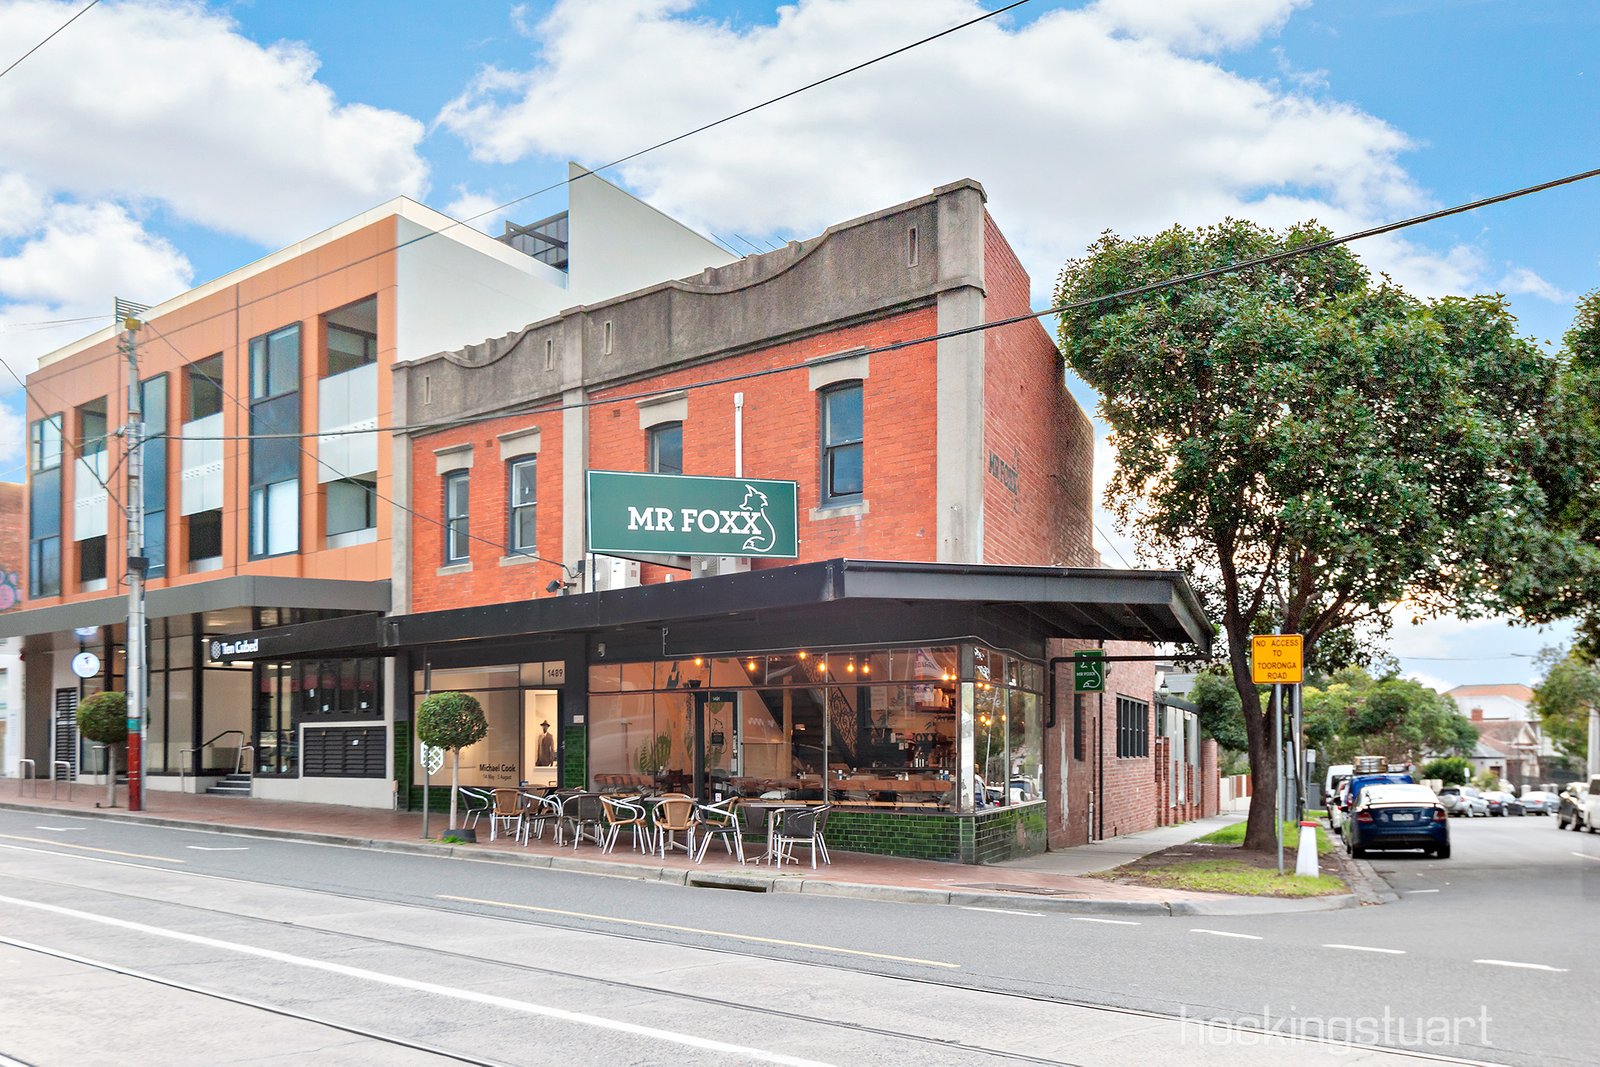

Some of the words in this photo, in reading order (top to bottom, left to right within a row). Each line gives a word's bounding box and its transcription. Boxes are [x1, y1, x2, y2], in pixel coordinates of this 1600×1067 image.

[627, 506, 675, 532] MR
[680, 508, 762, 535] FOXX
[221, 642, 235, 655] Ten
[234, 638, 259, 654] Cubed
[1271, 639, 1299, 647] ACCESS
[1273, 649, 1282, 657] TO
[1257, 662, 1297, 670] TOORONGA
[547, 668, 563, 678] 1489
[1267, 671, 1288, 680] ROAD
[479, 763, 500, 772] Michael
[501, 763, 516, 772] Cook
